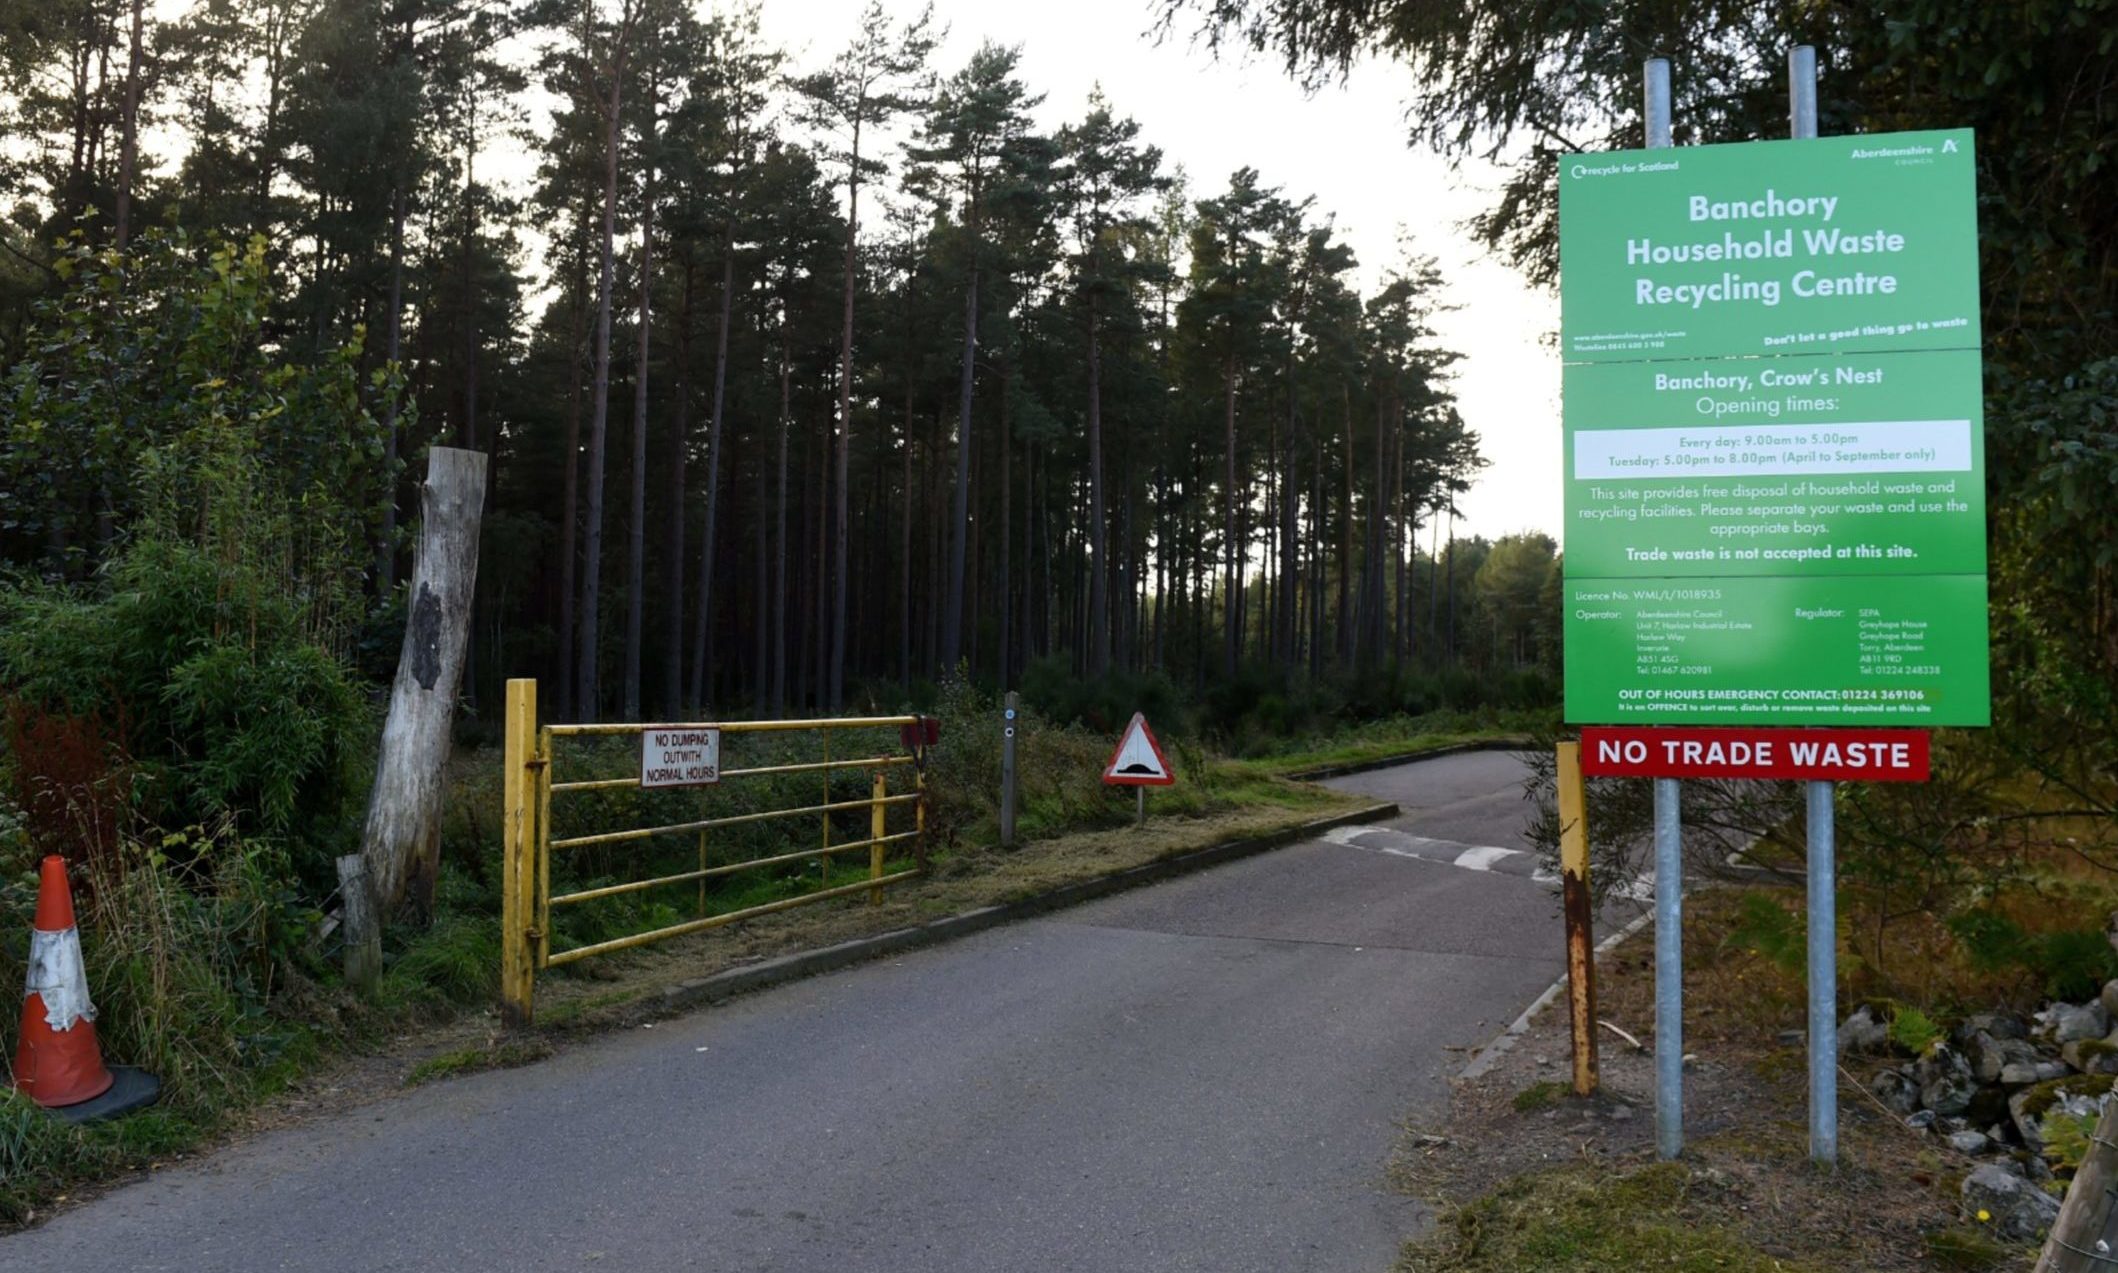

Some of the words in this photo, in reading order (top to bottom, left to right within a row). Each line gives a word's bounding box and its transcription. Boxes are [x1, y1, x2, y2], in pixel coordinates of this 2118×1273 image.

[1851, 145, 1933, 159] Aberdeenshire
[1587, 164, 1620, 176] recycle
[1622, 164, 1636, 172] for
[1638, 161, 1679, 171] Scotland
[1689, 189, 1837, 222] Banchory
[1627, 229, 1793, 264] Household
[1803, 228, 1904, 256] Waste
[1636, 273, 1780, 308] Recycling
[1792, 270, 1896, 297] Centre
[1764, 335, 1795, 346] Don't
[1799, 334, 1815, 342] let
[1830, 327, 1859, 341] good
[1863, 324, 1894, 336] thing
[1898, 323, 1913, 334] go
[1917, 321, 1928, 329] to
[1932, 318, 1968, 328] waste
[1656, 372, 1753, 392] Banchory,
[1760, 369, 1829, 387] Crow's
[1836, 367, 1882, 384] Nest
[1696, 397, 1780, 418] Opening
[1786, 395, 1839, 412] times:
[1680, 436, 1711, 449] Every
[1715, 435, 1740, 448] day:
[1745, 434, 1792, 446] 9.00am
[1795, 434, 1806, 445] to
[1812, 432, 1858, 446] 5.00pm
[1608, 454, 1659, 469] Tuesday:
[1664, 453, 1710, 467] 5.00pm
[1714, 454, 1725, 464] to
[1730, 451, 1777, 465] 8.00pm
[1782, 451, 1816, 464] (April
[1819, 451, 1831, 462] to
[1836, 449, 1900, 463] September
[1905, 448, 1936, 462] only)
[1591, 487, 1615, 500] This
[1618, 486, 1640, 499] site
[1644, 484, 1698, 500] provides
[1703, 484, 1728, 497] free
[1732, 483, 1788, 498] disposal
[1793, 483, 1806, 496] of
[1809, 482, 1879, 496] household
[1884, 482, 1923, 494] waste
[1927, 480, 1955, 493] and
[1579, 504, 1637, 521] recycling
[1640, 504, 1696, 517] facilities.
[1701, 502, 1743, 516] Please
[1747, 503, 1806, 518] separate
[1810, 503, 1840, 517] your
[1845, 502, 1883, 513] waste
[1888, 500, 1915, 513] and
[1920, 502, 1942, 512] use
[1947, 500, 1968, 512] the
[1711, 520, 1789, 537] appropriate
[1793, 520, 1829, 535] bays.
[1626, 547, 1668, 561] Trade
[1672, 548, 1715, 560] waste
[1719, 547, 1730, 559] is
[1735, 547, 1759, 559] not
[1763, 545, 1832, 562] accepted
[1837, 545, 1851, 558] at
[1856, 544, 1882, 558] this
[1887, 544, 1918, 557] site.
[1576, 592, 1609, 601] Licence
[1576, 610, 1621, 621] Operator:
[1693, 610, 1722, 618] Council
[1666, 633, 1686, 642] Way
[1619, 690, 1643, 699] OUT
[1646, 690, 1662, 699] OF
[1665, 690, 1705, 699] HOURS
[1708, 690, 1779, 699] EMERGENCY
[1782, 690, 1841, 700] CONTACT:
[1842, 690, 1877, 700] 01224
[1881, 690, 1924, 700] 369106
[1842, 704, 1883, 713] deposited
[1899, 704, 1914, 712] this
[1916, 704, 1930, 712] site
[656, 734, 668, 746] NO
[672, 733, 708, 746] DUMPING
[664, 751, 701, 763] OUTWITH
[1599, 741, 1647, 763] NO
[1662, 741, 1773, 766] TRADE
[1790, 743, 1909, 768] WASTE
[647, 768, 683, 782] NORMAL
[687, 766, 714, 779] HOURS
